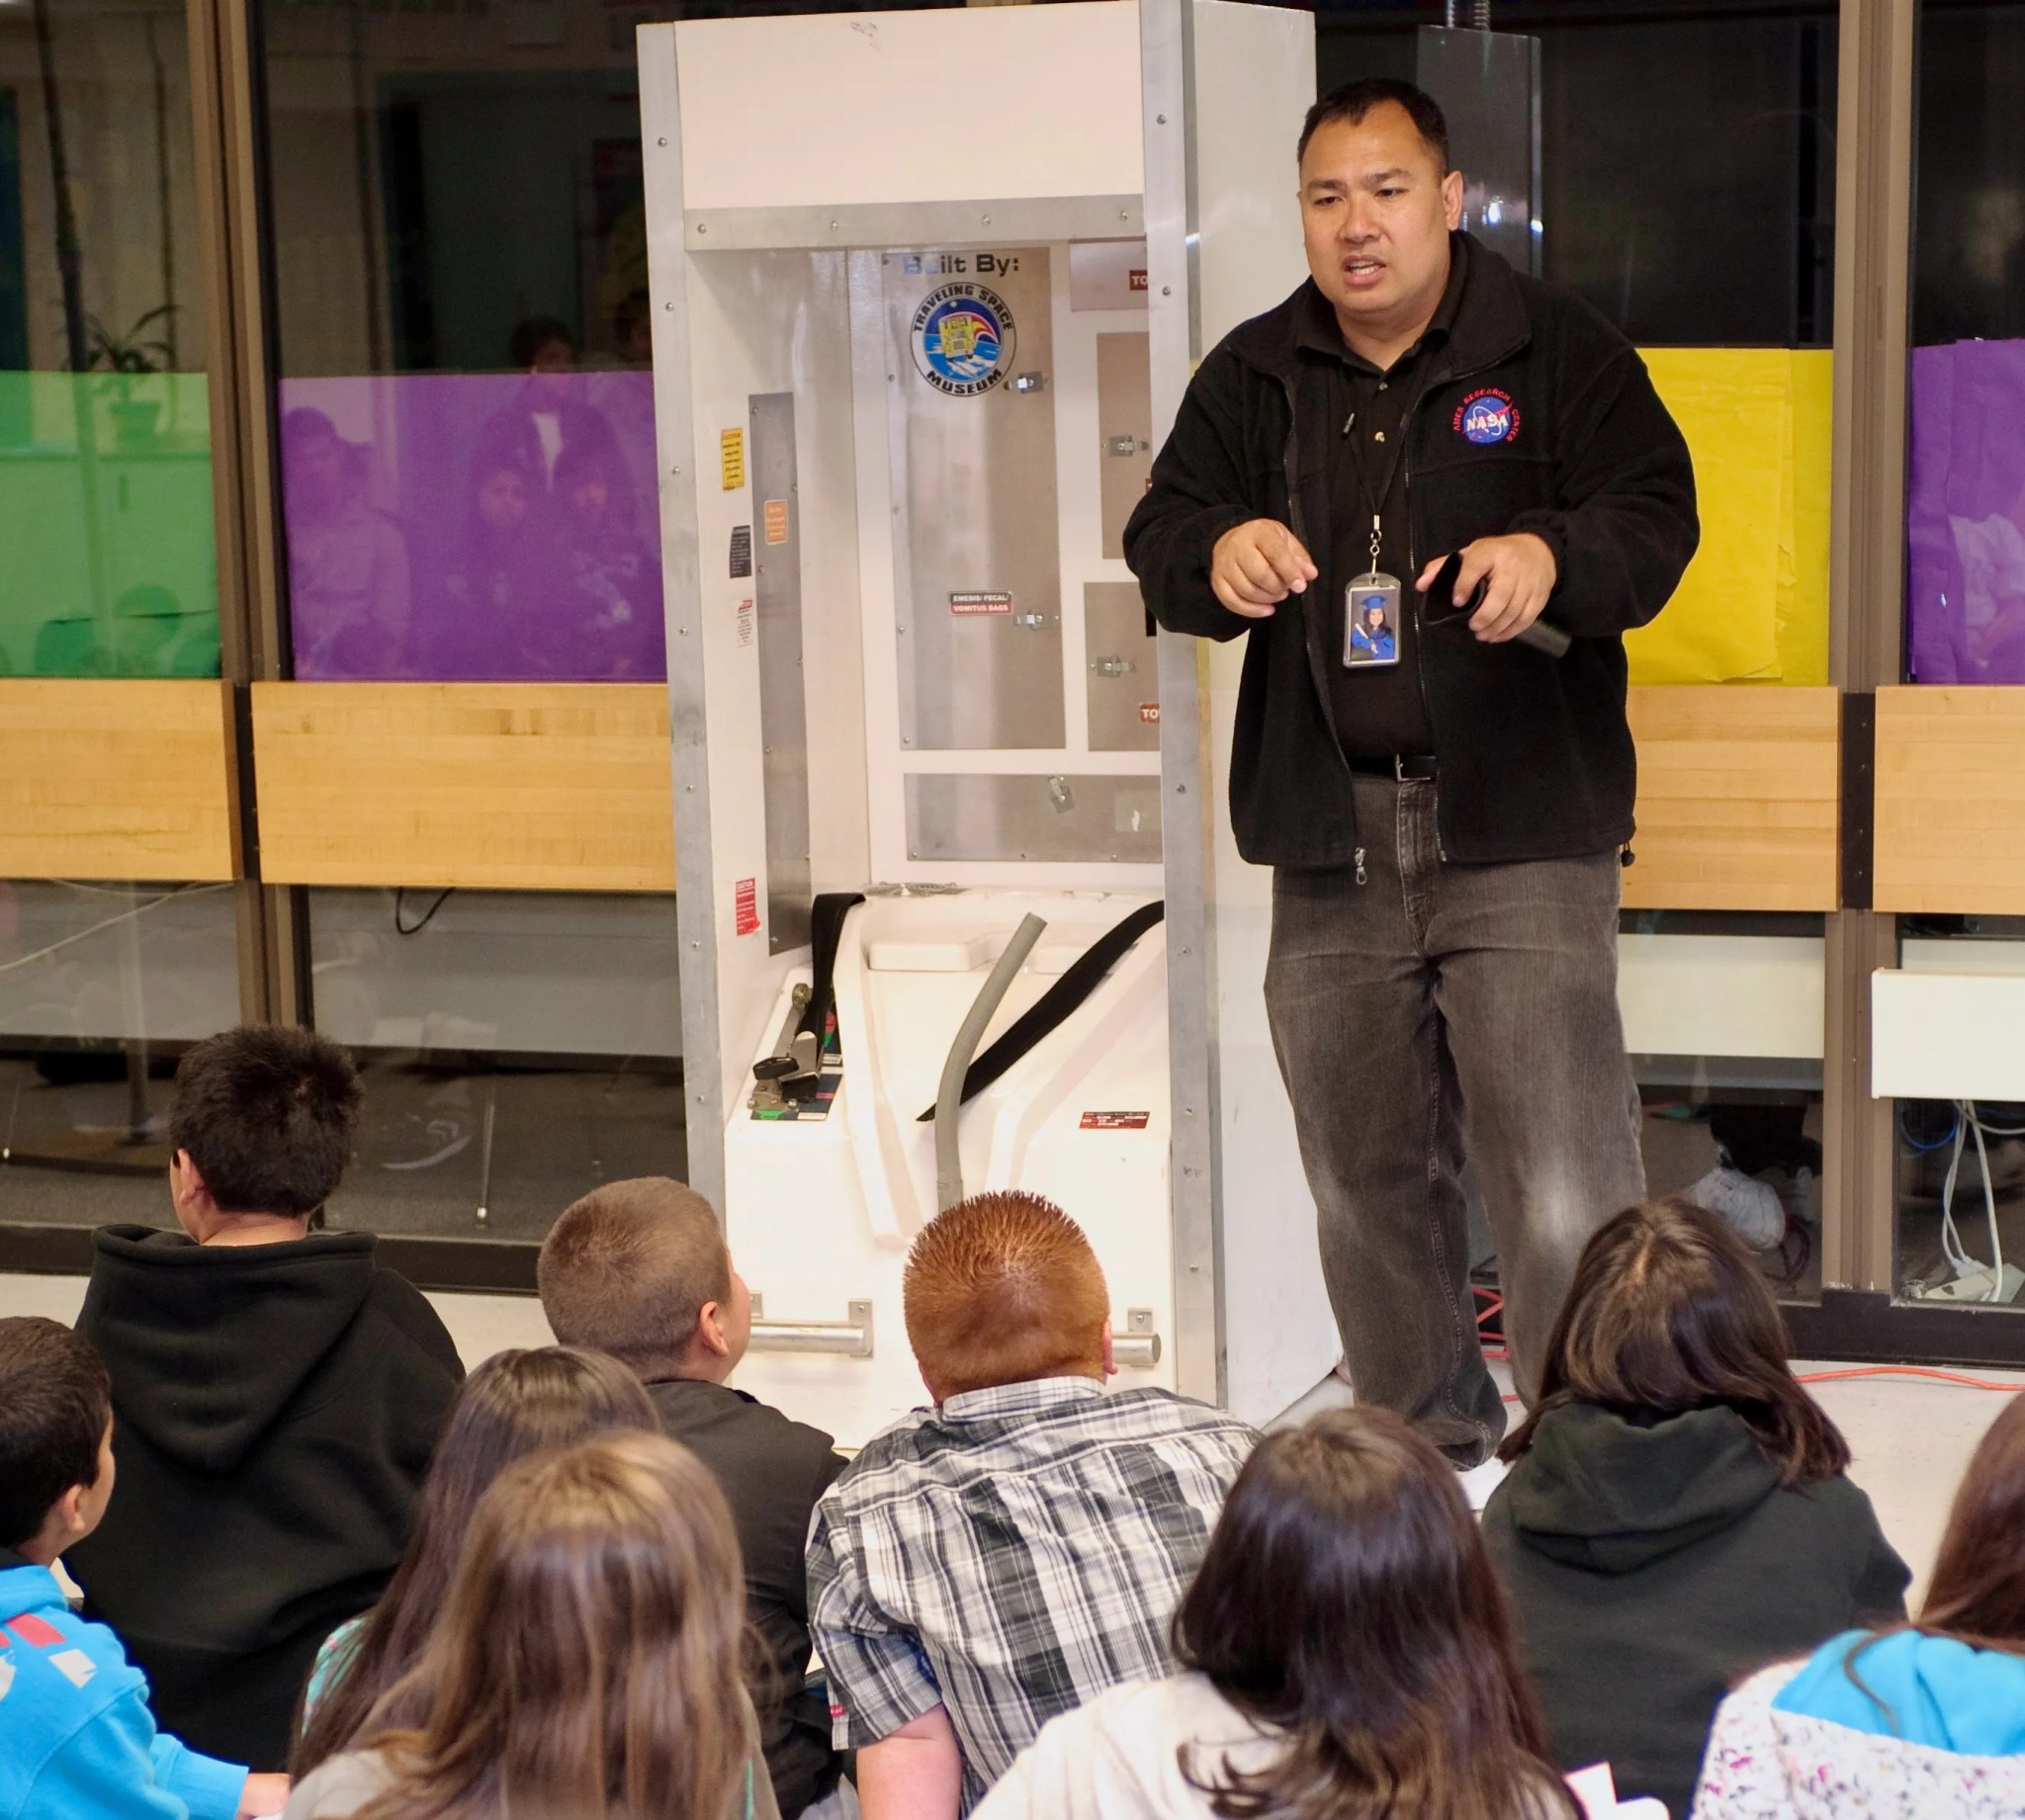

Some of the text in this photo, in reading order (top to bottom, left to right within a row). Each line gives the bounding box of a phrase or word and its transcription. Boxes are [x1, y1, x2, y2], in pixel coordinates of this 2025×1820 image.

[976, 253, 1019, 277] By:
[914, 285, 1013, 331] TRAVELING SPACE
[926, 369, 1003, 394] MUSEUM
[1453, 388, 1521, 442] AMES RESEARCH CENTER
[1466, 413, 1509, 431] NASA
